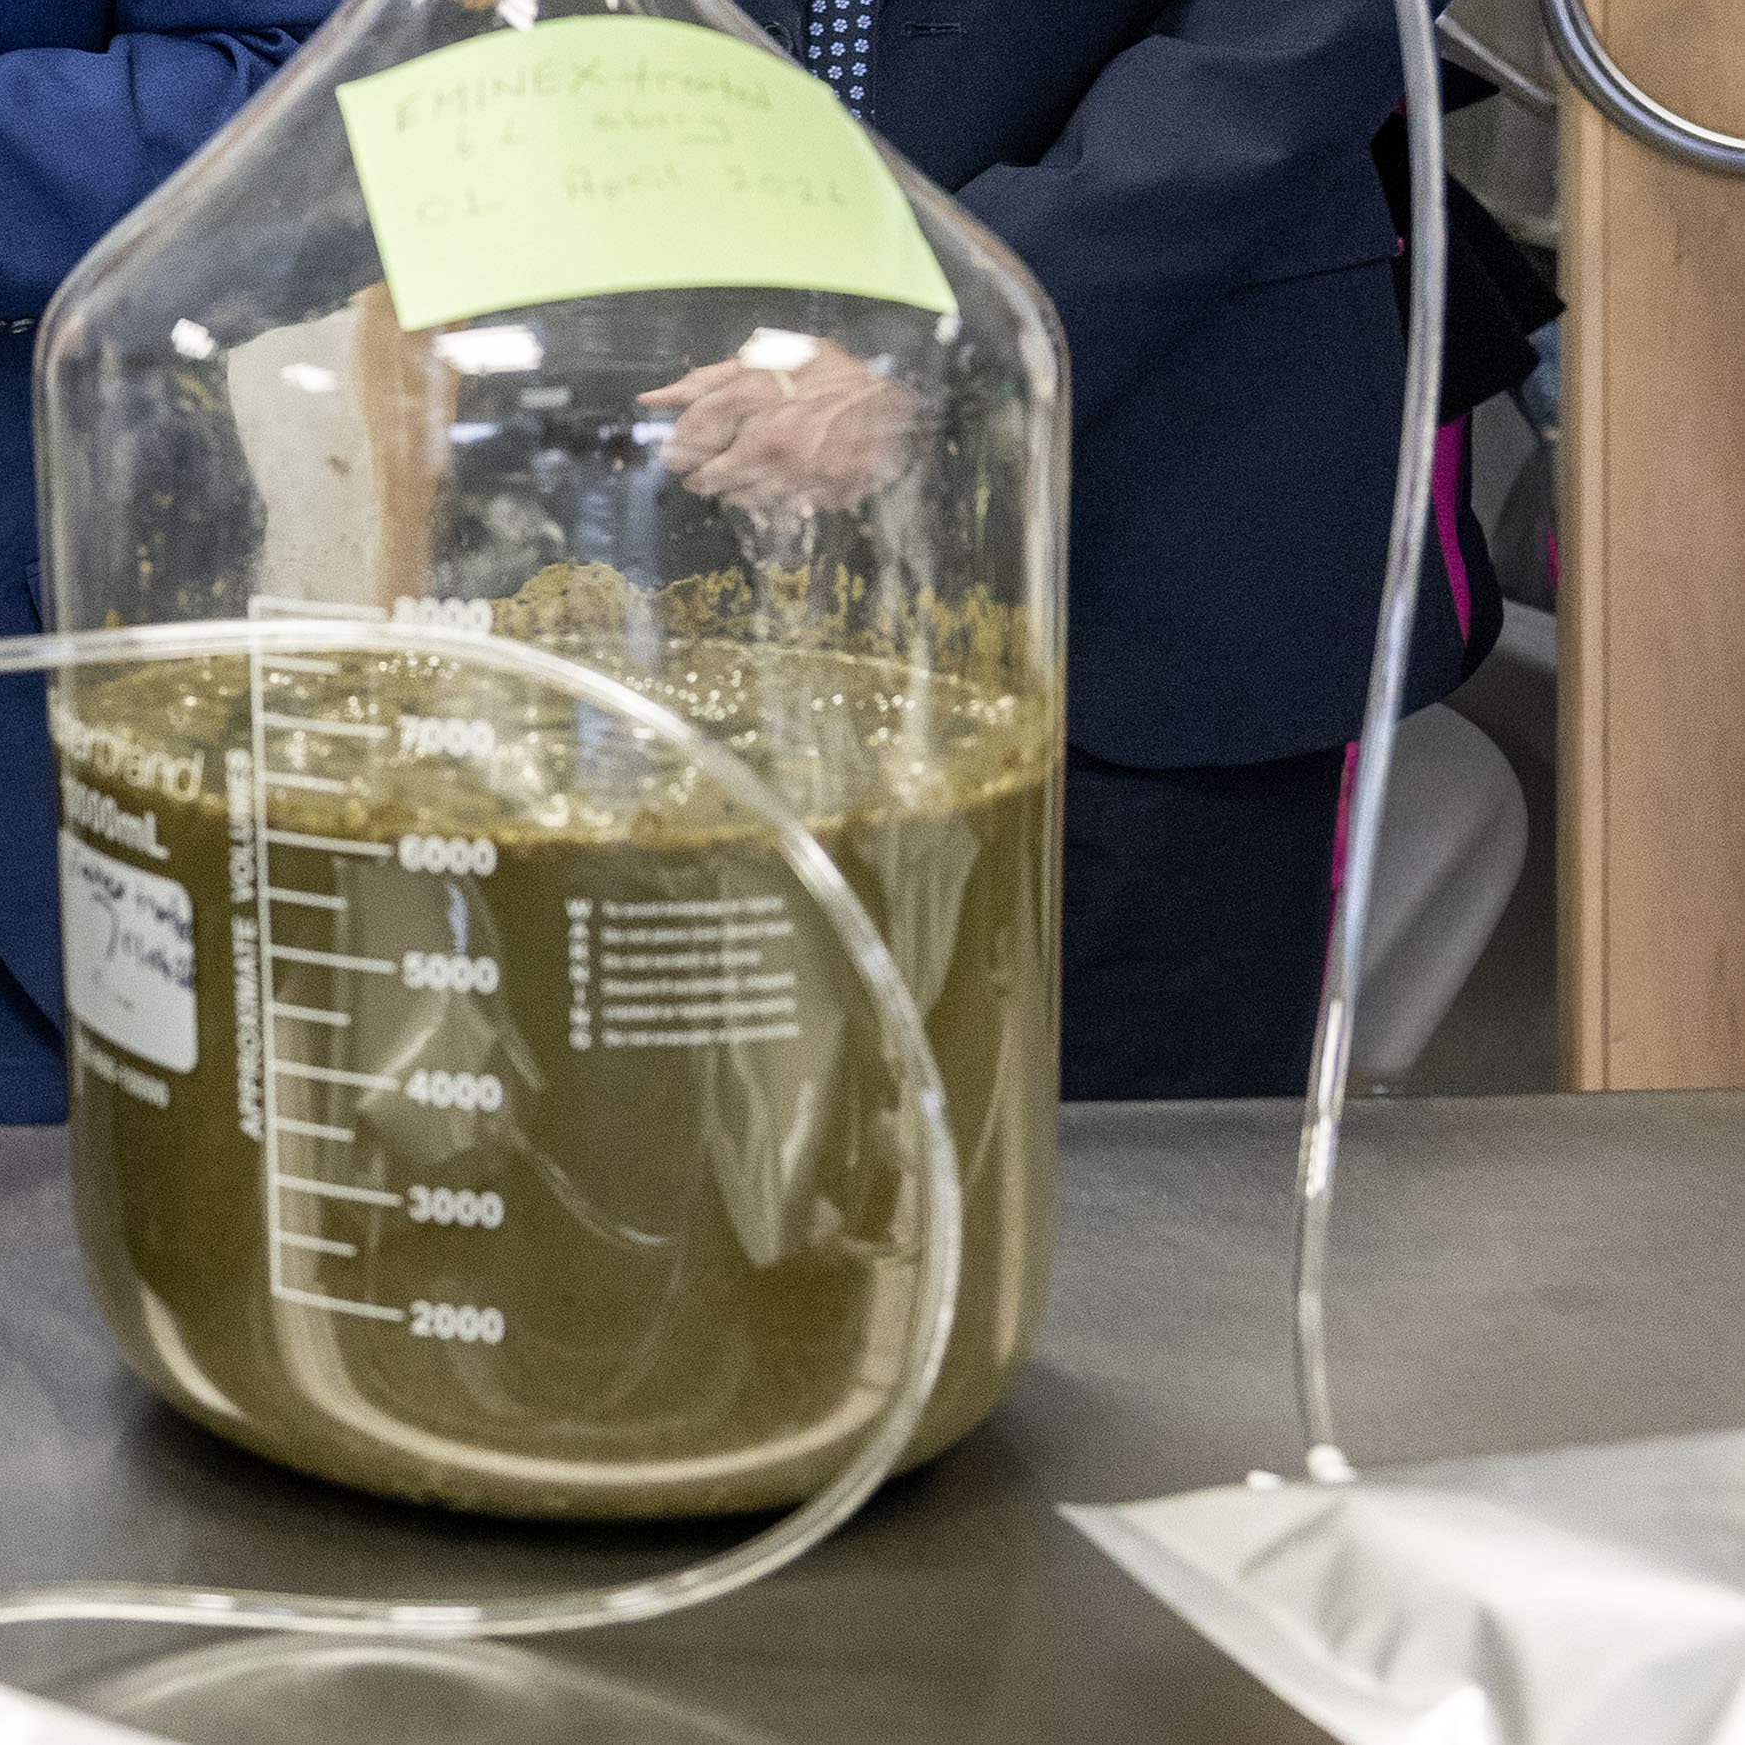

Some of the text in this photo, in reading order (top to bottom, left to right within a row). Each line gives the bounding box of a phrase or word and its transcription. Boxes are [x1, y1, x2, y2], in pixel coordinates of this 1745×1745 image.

[397, 833, 498, 878] 6000
[400, 951, 500, 996] 5000
[404, 1070, 504, 1112] 4000
[408, 1190, 505, 1231] 3000
[409, 1302, 507, 1345] 2000
